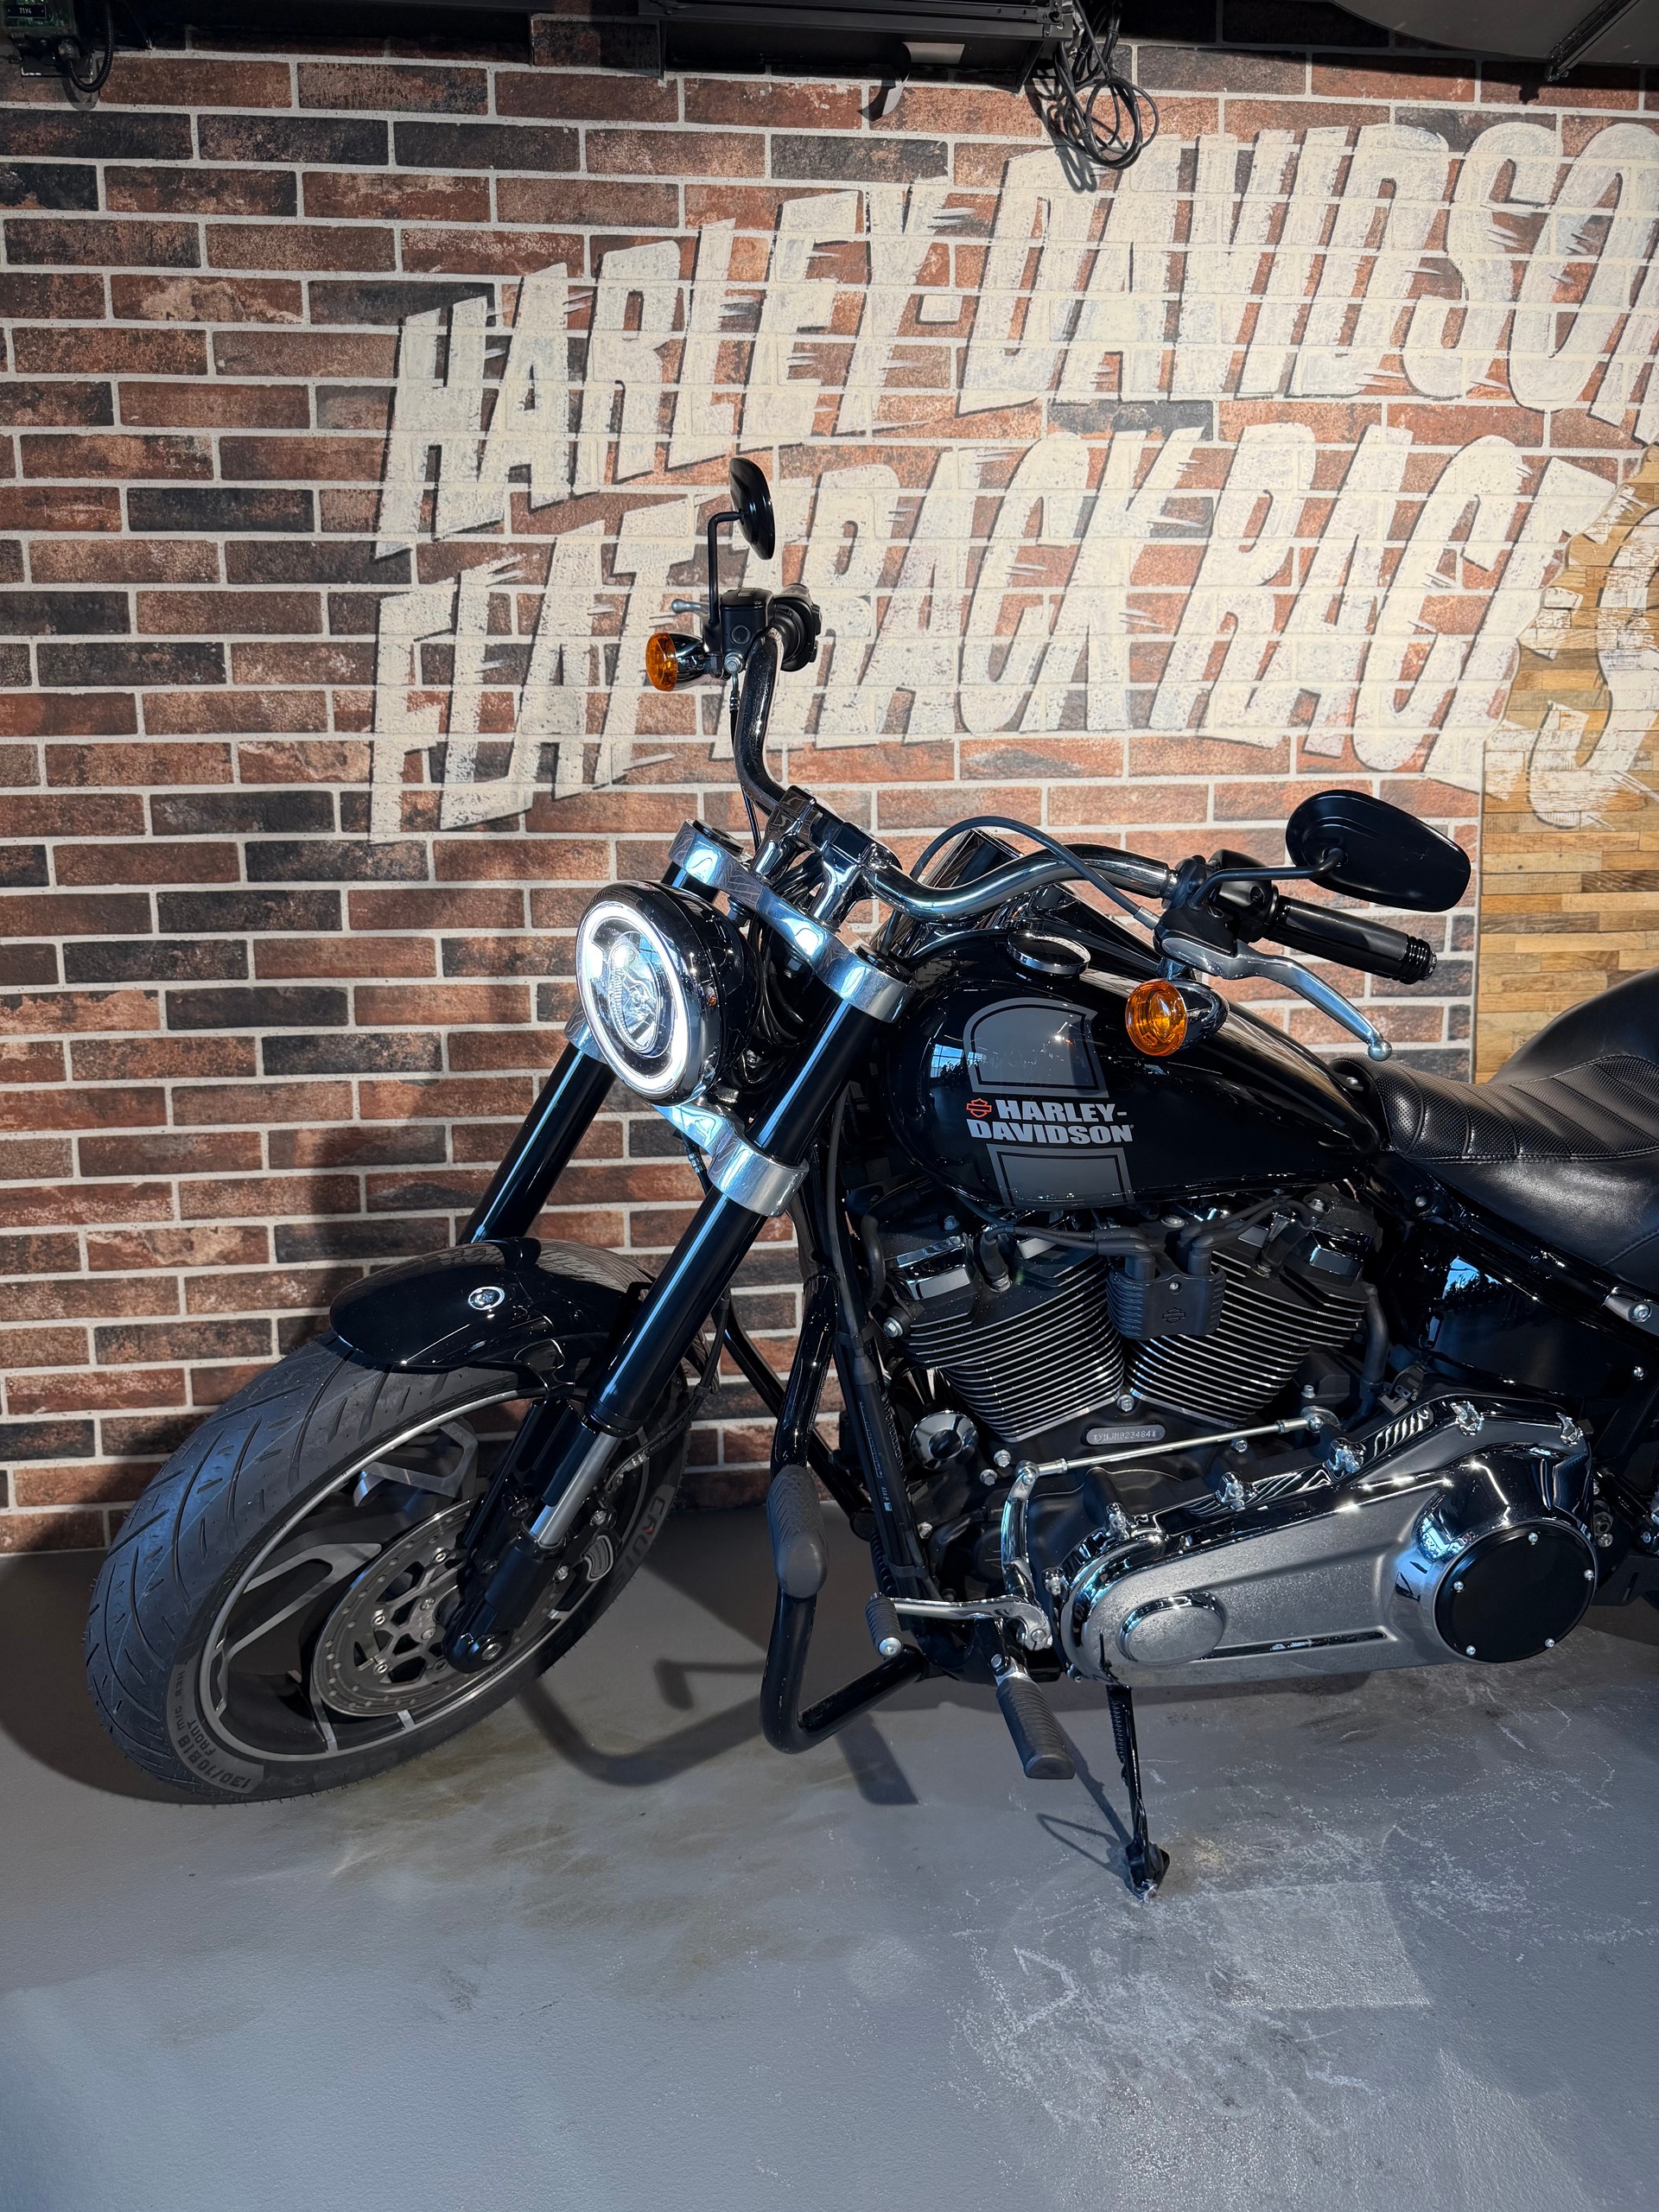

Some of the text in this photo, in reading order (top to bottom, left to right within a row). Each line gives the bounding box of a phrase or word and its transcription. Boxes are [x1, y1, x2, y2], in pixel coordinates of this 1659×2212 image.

[370, 494, 728, 845] FLAT
[995, 1099, 1128, 1122] HARLEY-
[966, 1118, 1134, 1145] DAVIDSON
